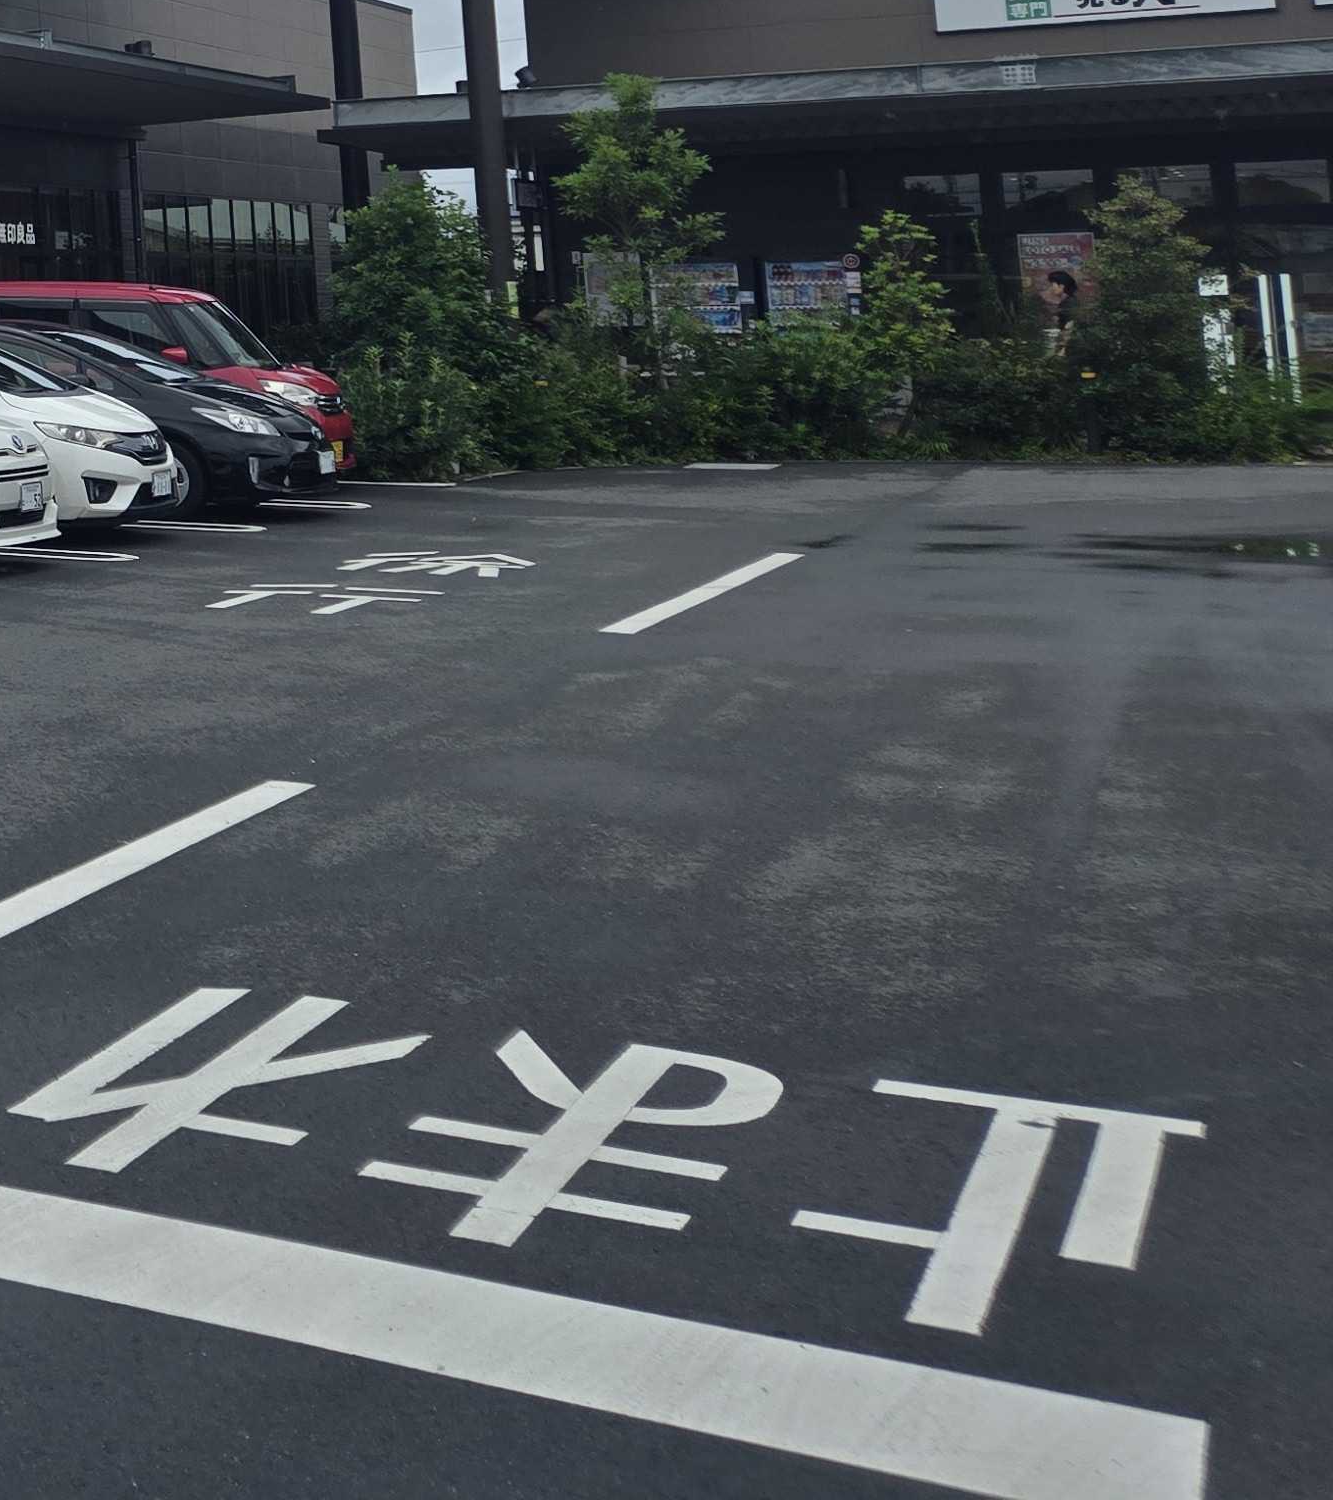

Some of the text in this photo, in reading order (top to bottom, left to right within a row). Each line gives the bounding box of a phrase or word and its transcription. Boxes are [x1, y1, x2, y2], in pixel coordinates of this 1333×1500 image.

[1009, 1, 1050, 18] 専門
[6, 986, 1209, 1337] 止まれ
